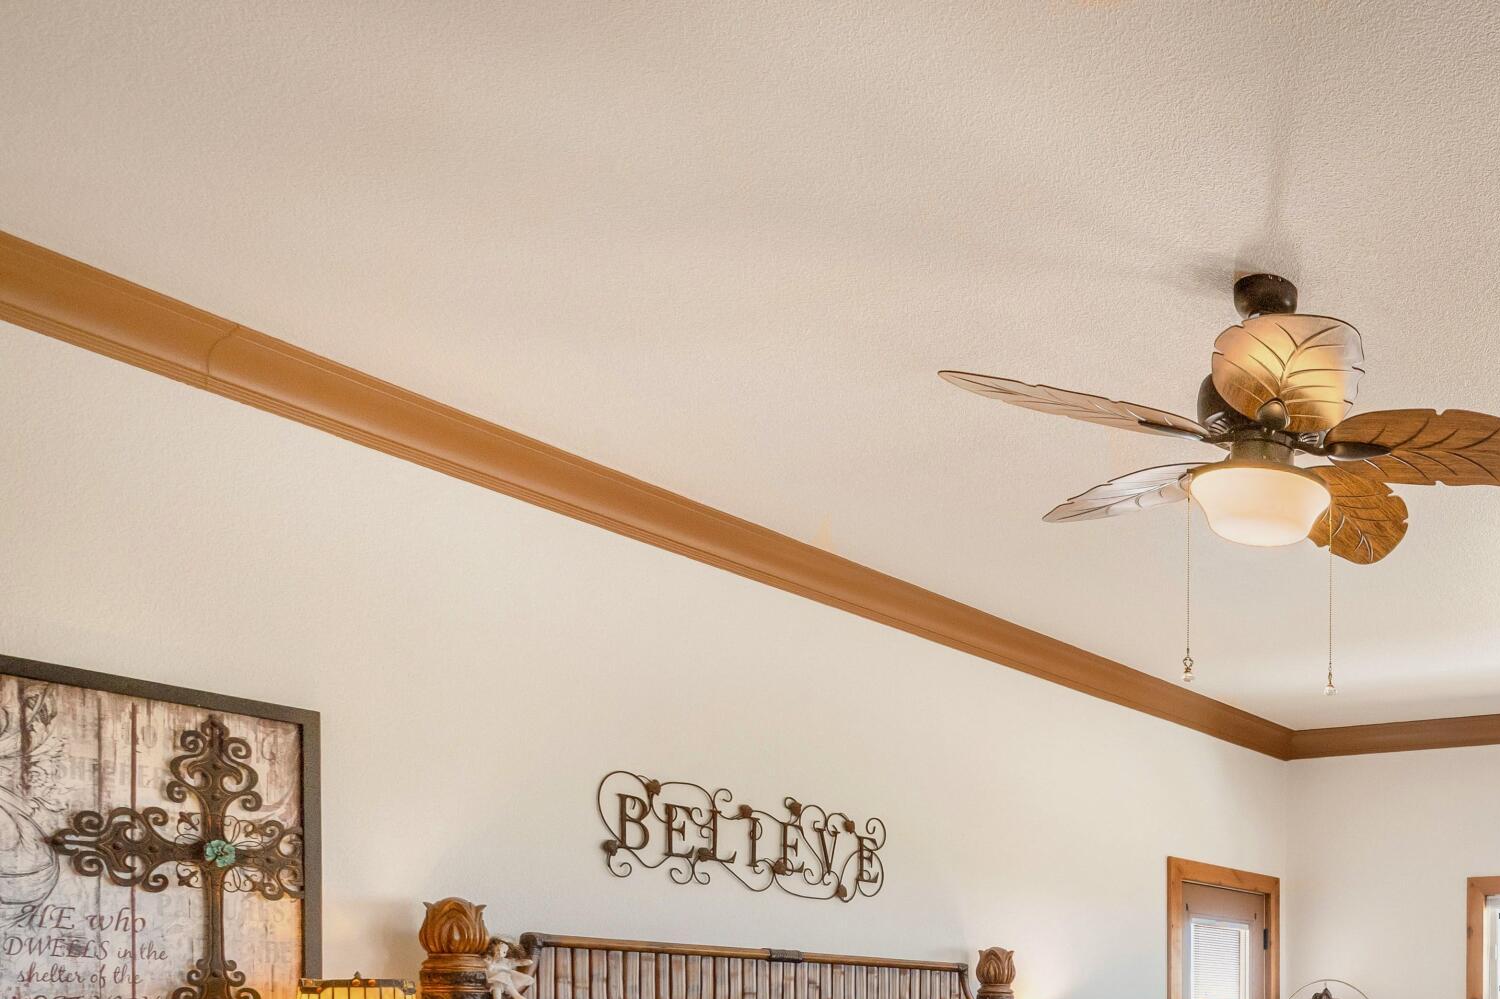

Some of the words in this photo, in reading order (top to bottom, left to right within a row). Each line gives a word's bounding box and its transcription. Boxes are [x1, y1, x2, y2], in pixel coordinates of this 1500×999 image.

[616, 791, 881, 885] BELIEVE
[18, 904, 76, 930] HE
[86, 906, 147, 933] who
[3, 936, 110, 961] DWELLS
[117, 947, 135, 960] in
[136, 940, 169, 961] the
[17, 961, 86, 984] shelter
[90, 963, 107, 989] of
[113, 964, 144, 984] the
